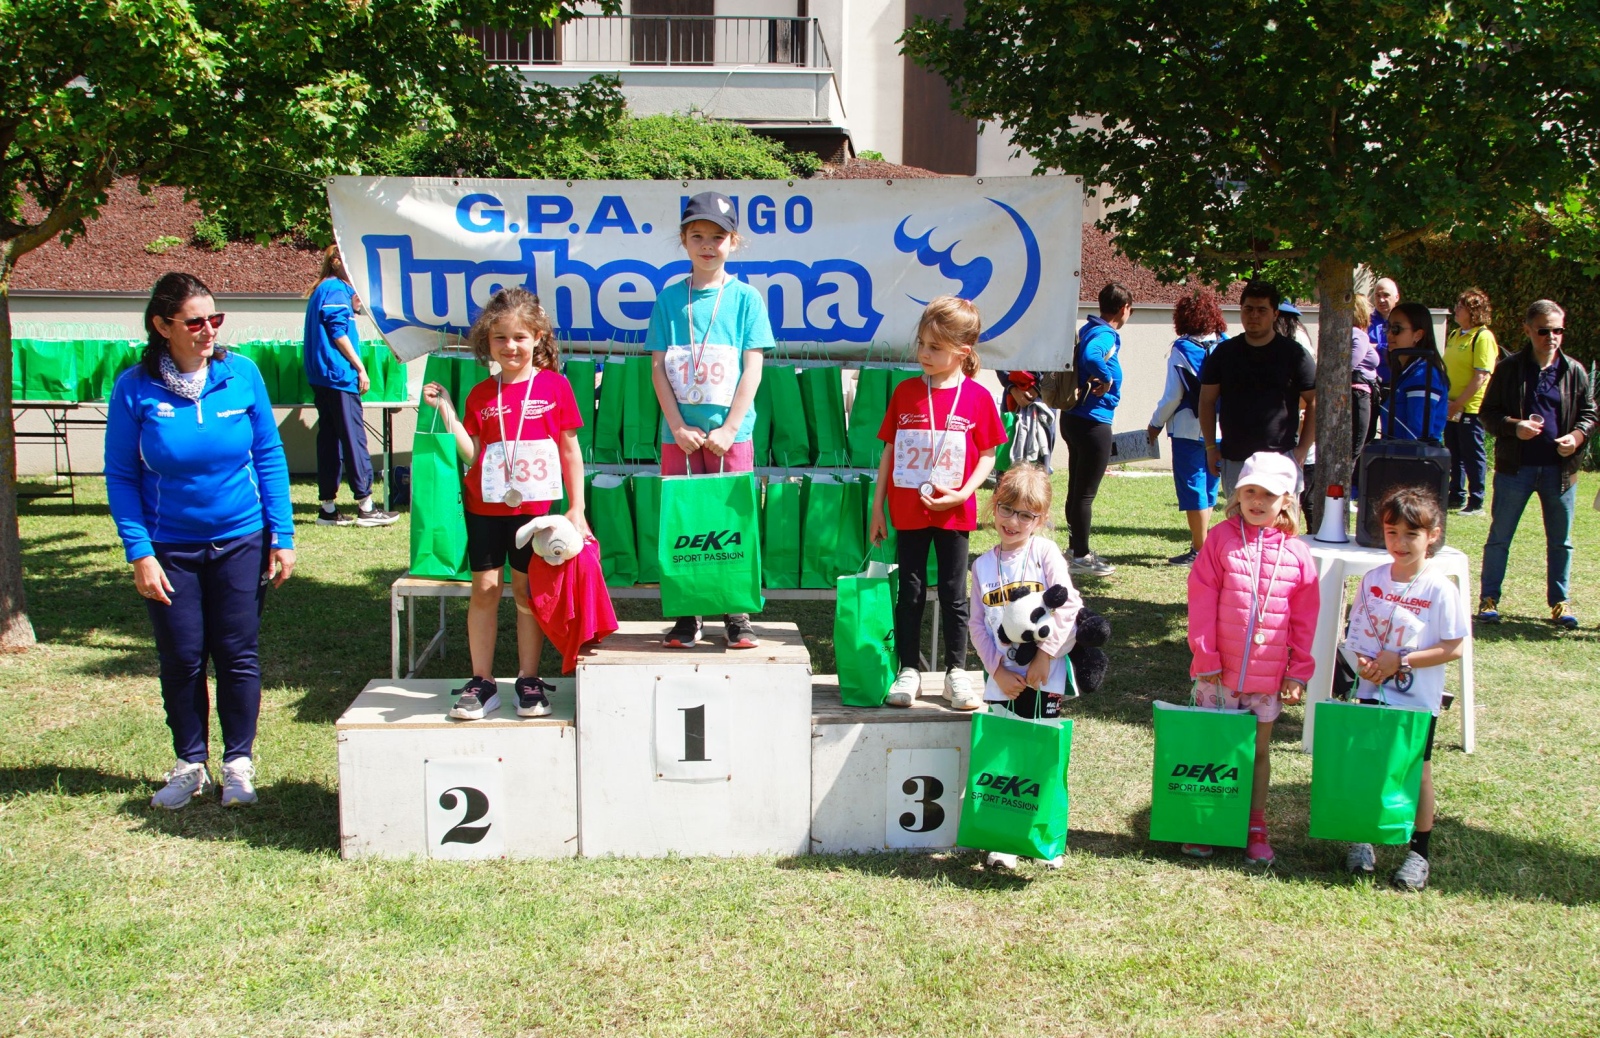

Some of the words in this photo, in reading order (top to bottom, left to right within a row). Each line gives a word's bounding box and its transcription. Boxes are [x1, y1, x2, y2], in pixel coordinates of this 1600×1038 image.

[455, 193, 653, 234] G.P.A.
[678, 361, 725, 385] 199
[497, 458, 548, 483] 133
[906, 447, 953, 470] 274
[673, 529, 742, 551] DEKA
[673, 554, 702, 563] SPORT
[704, 551, 744, 561] PASSION
[1364, 614, 1406, 647] 321
[677, 704, 712, 762] 1
[976, 772, 1040, 797] DEKA
[1171, 763, 1239, 783] DEKA
[1168, 783, 1197, 792] SPORT
[1200, 785, 1239, 794] PASSION
[899, 775, 945, 833] 3
[971, 792, 1000, 804] SPORT
[1001, 797, 1039, 811] PASSION
[438, 786, 492, 845] 2
